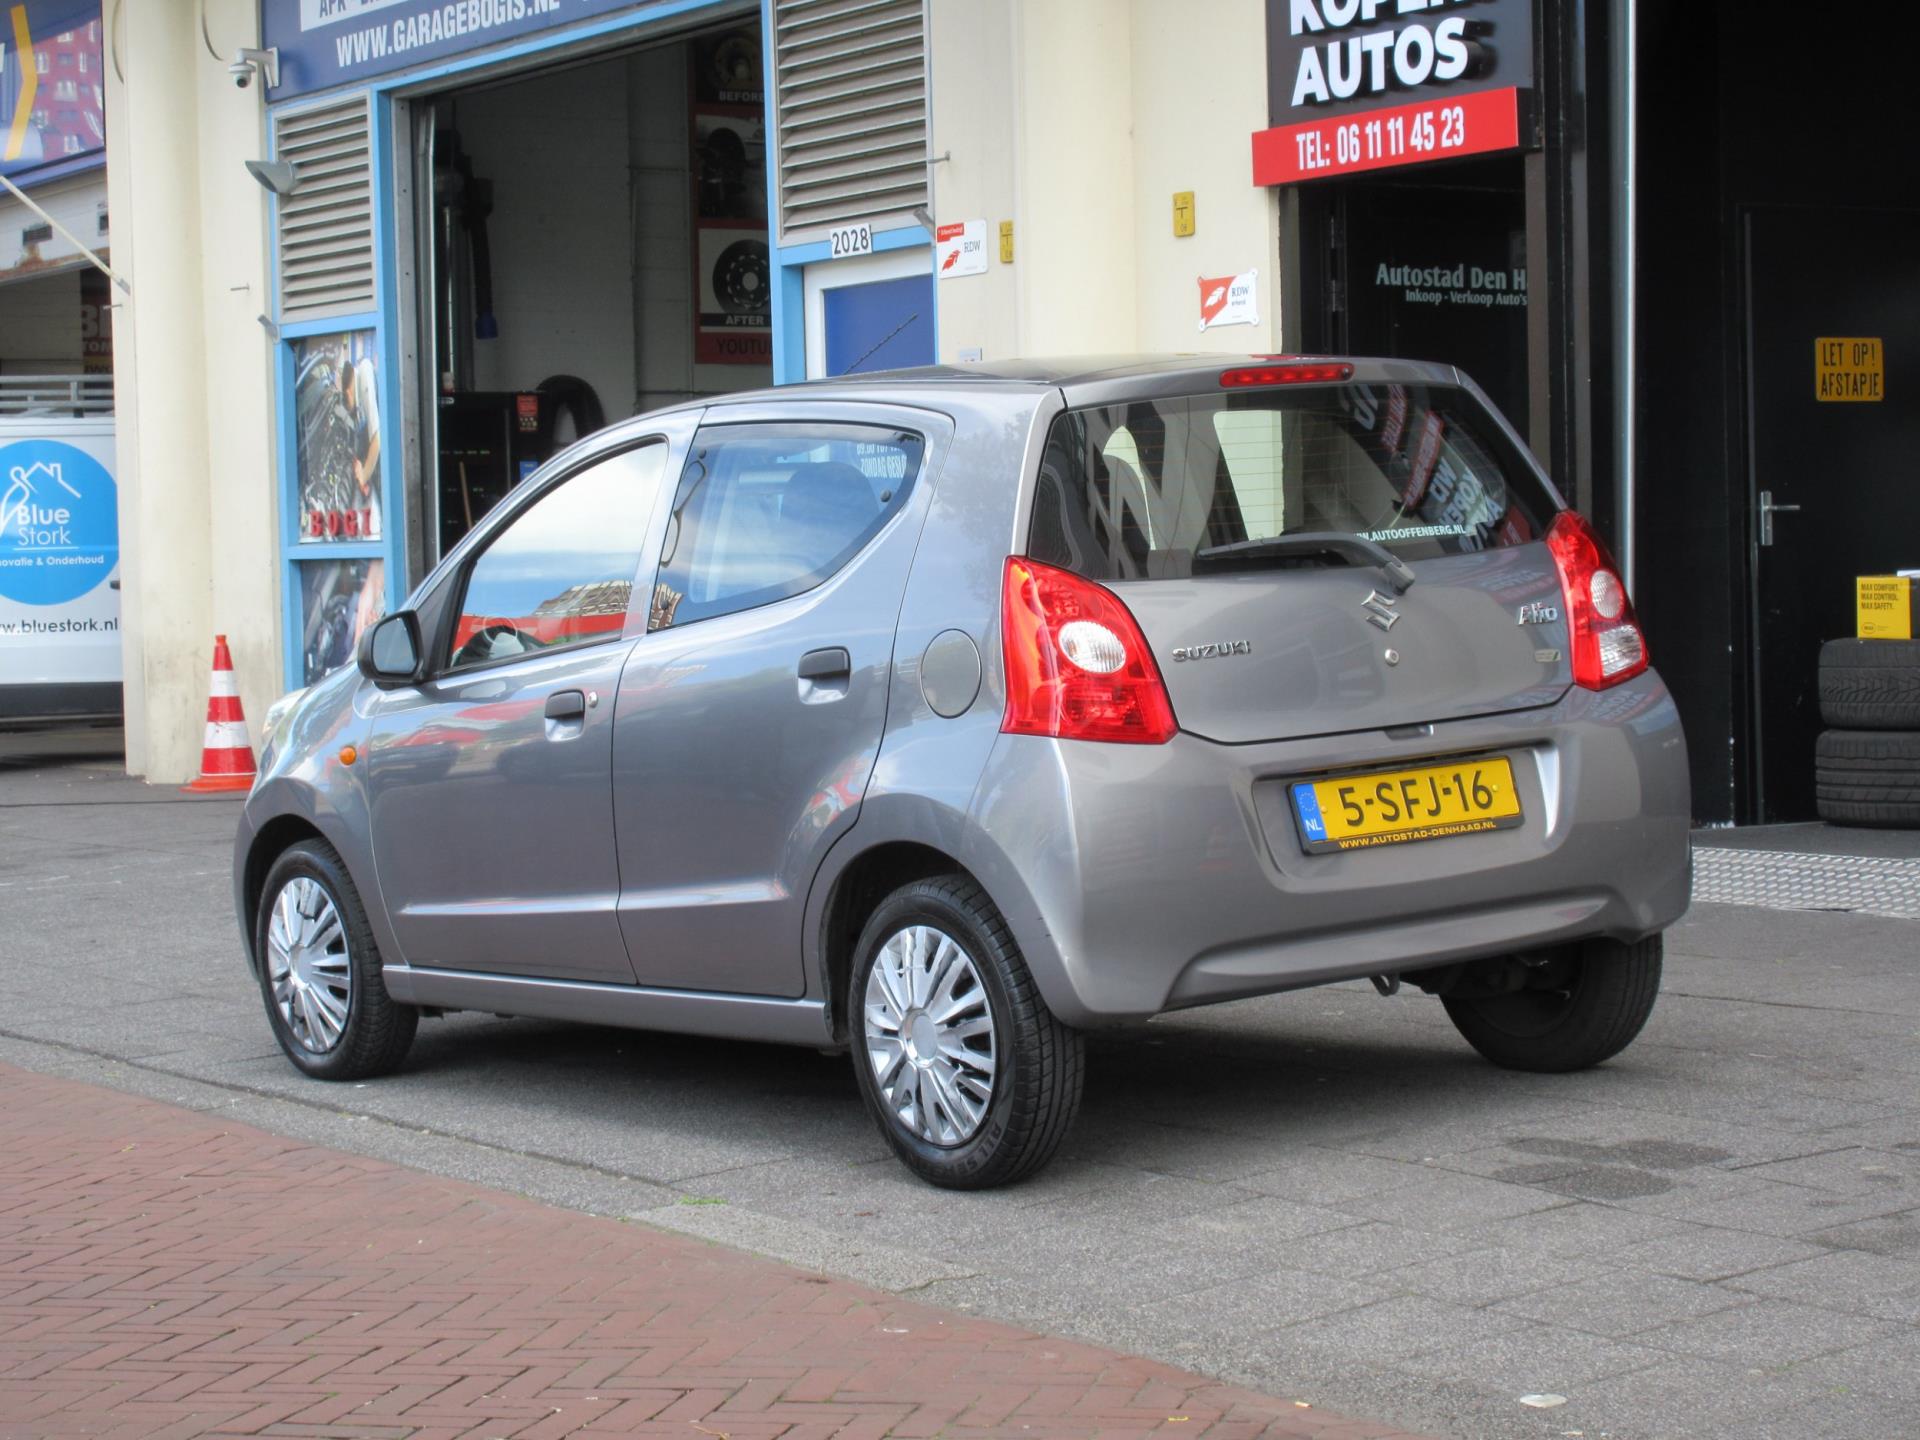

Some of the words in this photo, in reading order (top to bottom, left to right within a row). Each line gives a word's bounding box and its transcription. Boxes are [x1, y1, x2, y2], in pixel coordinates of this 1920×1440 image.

[1291, 17, 1468, 107] AUTOS
[1296, 131, 1331, 170] TEL:
[1337, 124, 1360, 164] 06
[1365, 120, 1382, 159] 11
[1387, 116, 1404, 156] 11
[1410, 112, 1435, 152] 45
[1440, 106, 1465, 148] 23
[832, 227, 870, 255] 2028
[964, 240, 981, 253] RDW
[1376, 263, 1464, 288] Autostad
[1471, 267, 1507, 290] Den
[1513, 268, 1527, 291] H
[1231, 286, 1250, 298] RDW
[1406, 288, 1442, 306] Inkoop
[1450, 290, 1493, 308] Verkoop
[725, 314, 764, 326] AFTER
[1823, 342, 1844, 367] LET
[1853, 342, 1875, 367] OP!
[1821, 372, 1880, 397] AFSTAPJE
[17, 503, 71, 526] Blue
[310, 507, 371, 538] BOGI
[17, 526, 72, 546] Stork
[1354, 524, 1467, 542] W.AUTOOFFENBERG.NL
[0, 556, 33, 566] ovatie
[36, 556, 44, 566] &
[47, 555, 104, 566] Onderhoud
[1518, 601, 1558, 625] Alto
[0, 617, 118, 634] w.bluestork.nl
[1172, 640, 1251, 662] SUZUKI
[1338, 769, 1493, 827] 5-SFJ-16
[1305, 818, 1323, 832] NL
[1339, 821, 1497, 849] WWW.AUTOSTAD-DENHAAG.NL
